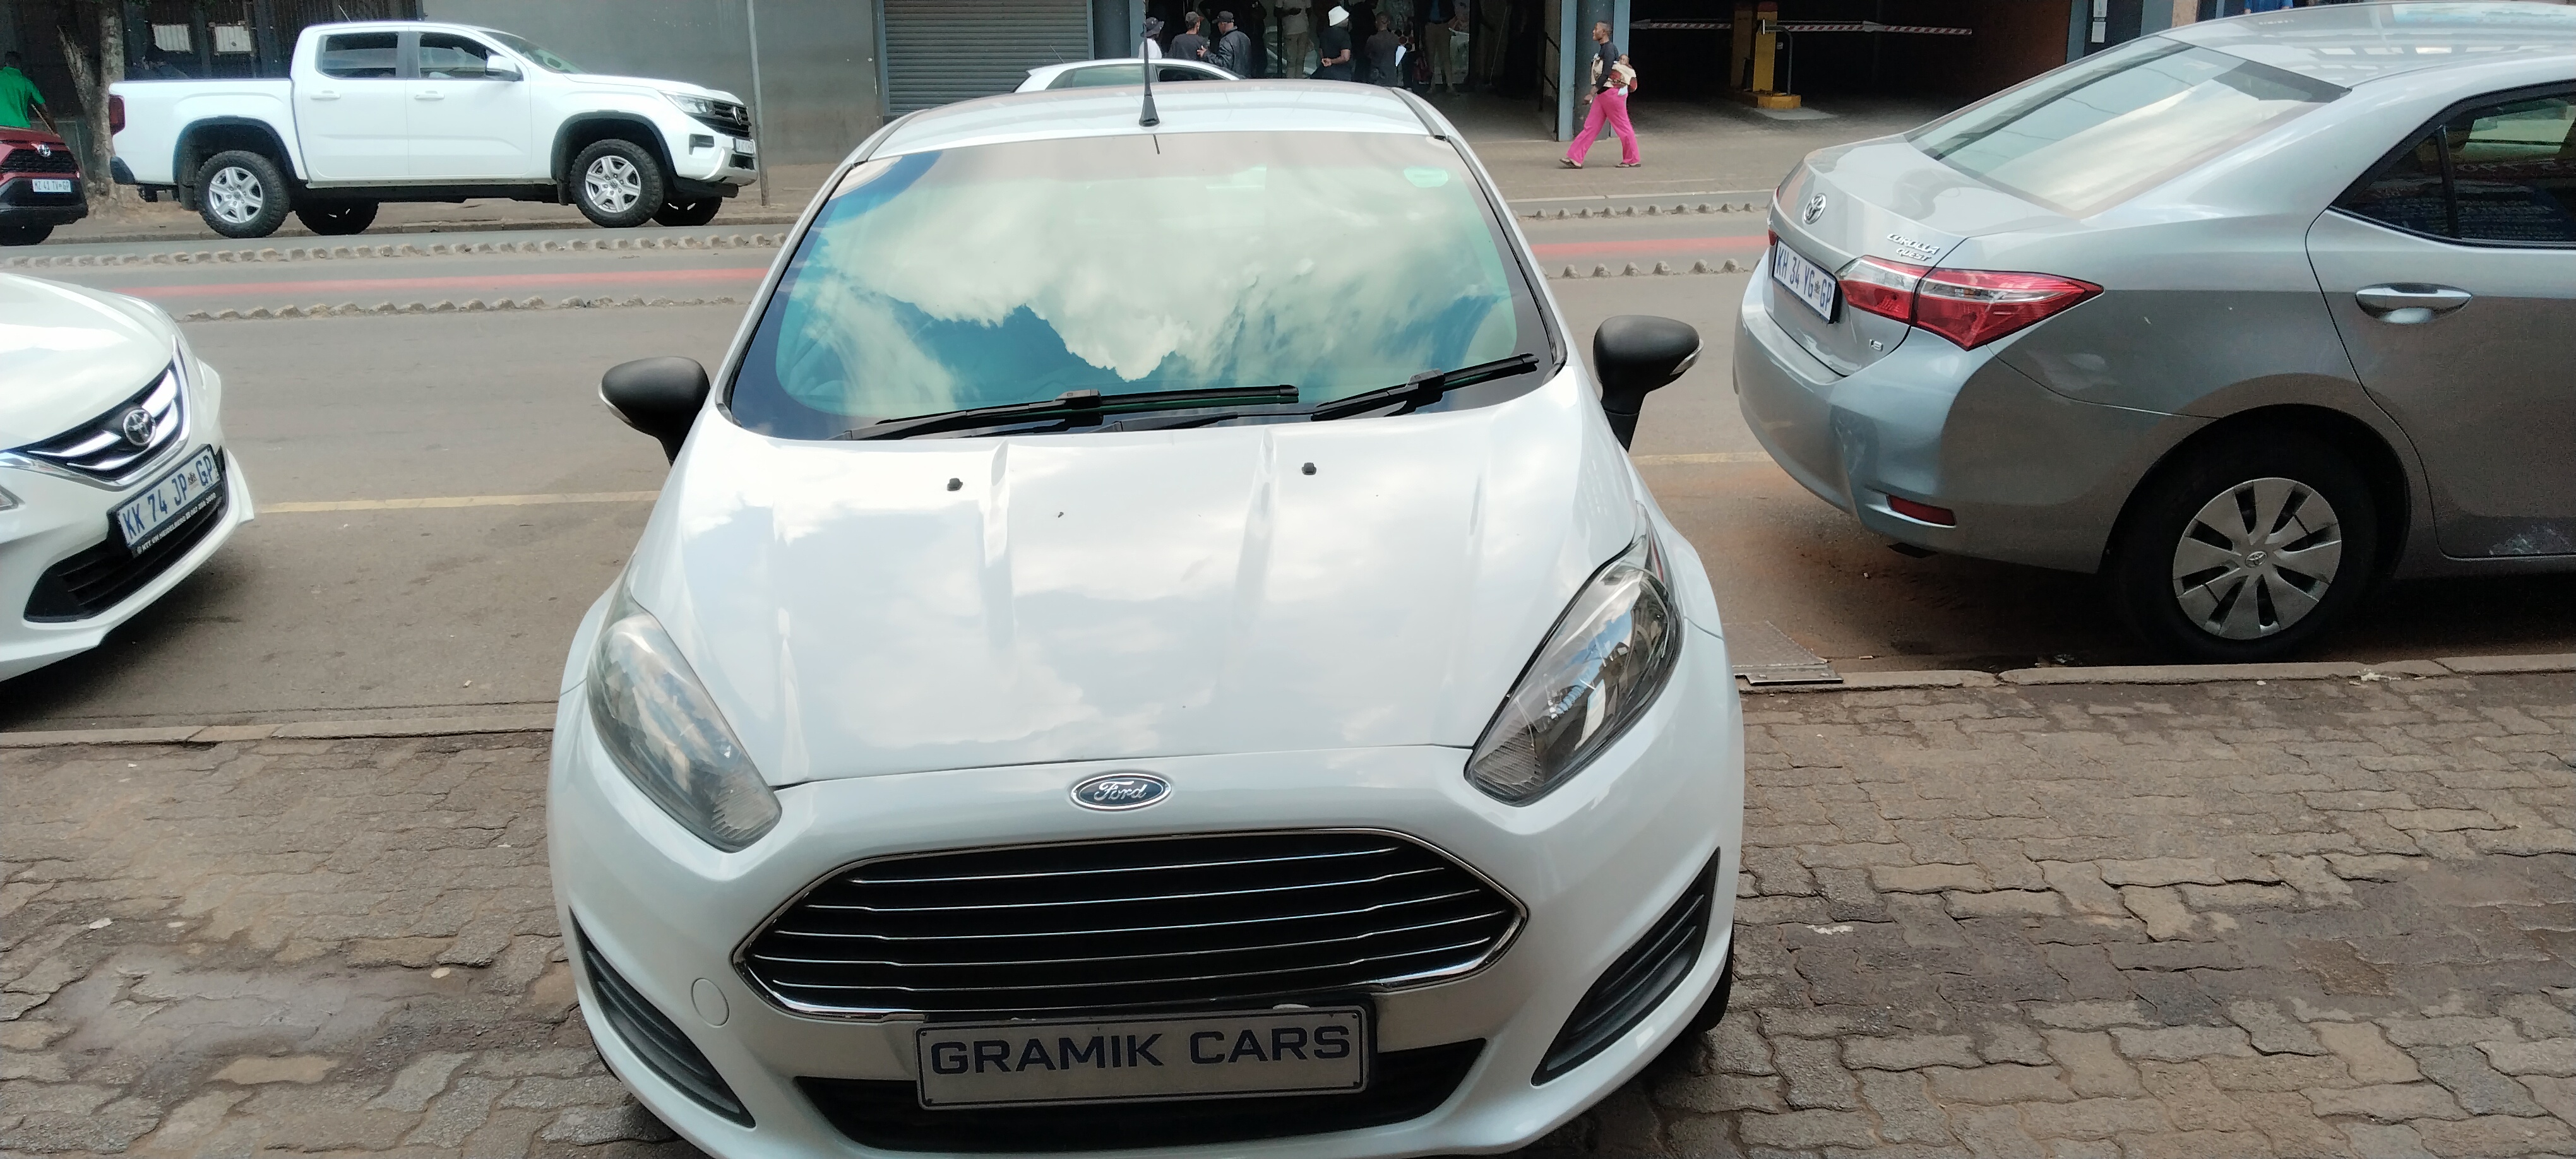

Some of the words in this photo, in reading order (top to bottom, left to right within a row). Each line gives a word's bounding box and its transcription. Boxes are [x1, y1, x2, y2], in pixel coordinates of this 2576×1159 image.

[43, 181, 51, 191] 41
[1887, 233, 1941, 256] COROLLA
[1895, 247, 1932, 261] QUEST
[1776, 246, 1789, 280] KH
[1789, 256, 1801, 290] 34
[1803, 264, 1815, 300] YG
[1820, 278, 1833, 312] GP
[122, 502, 146, 540] KK
[147, 489, 169, 523] 74
[171, 473, 188, 506] JP
[195, 455, 213, 487] GP
[1094, 780, 1148, 801] Ford
[930, 1032, 1164, 1075] GRAMIK
[1189, 1024, 1352, 1065] CARS
